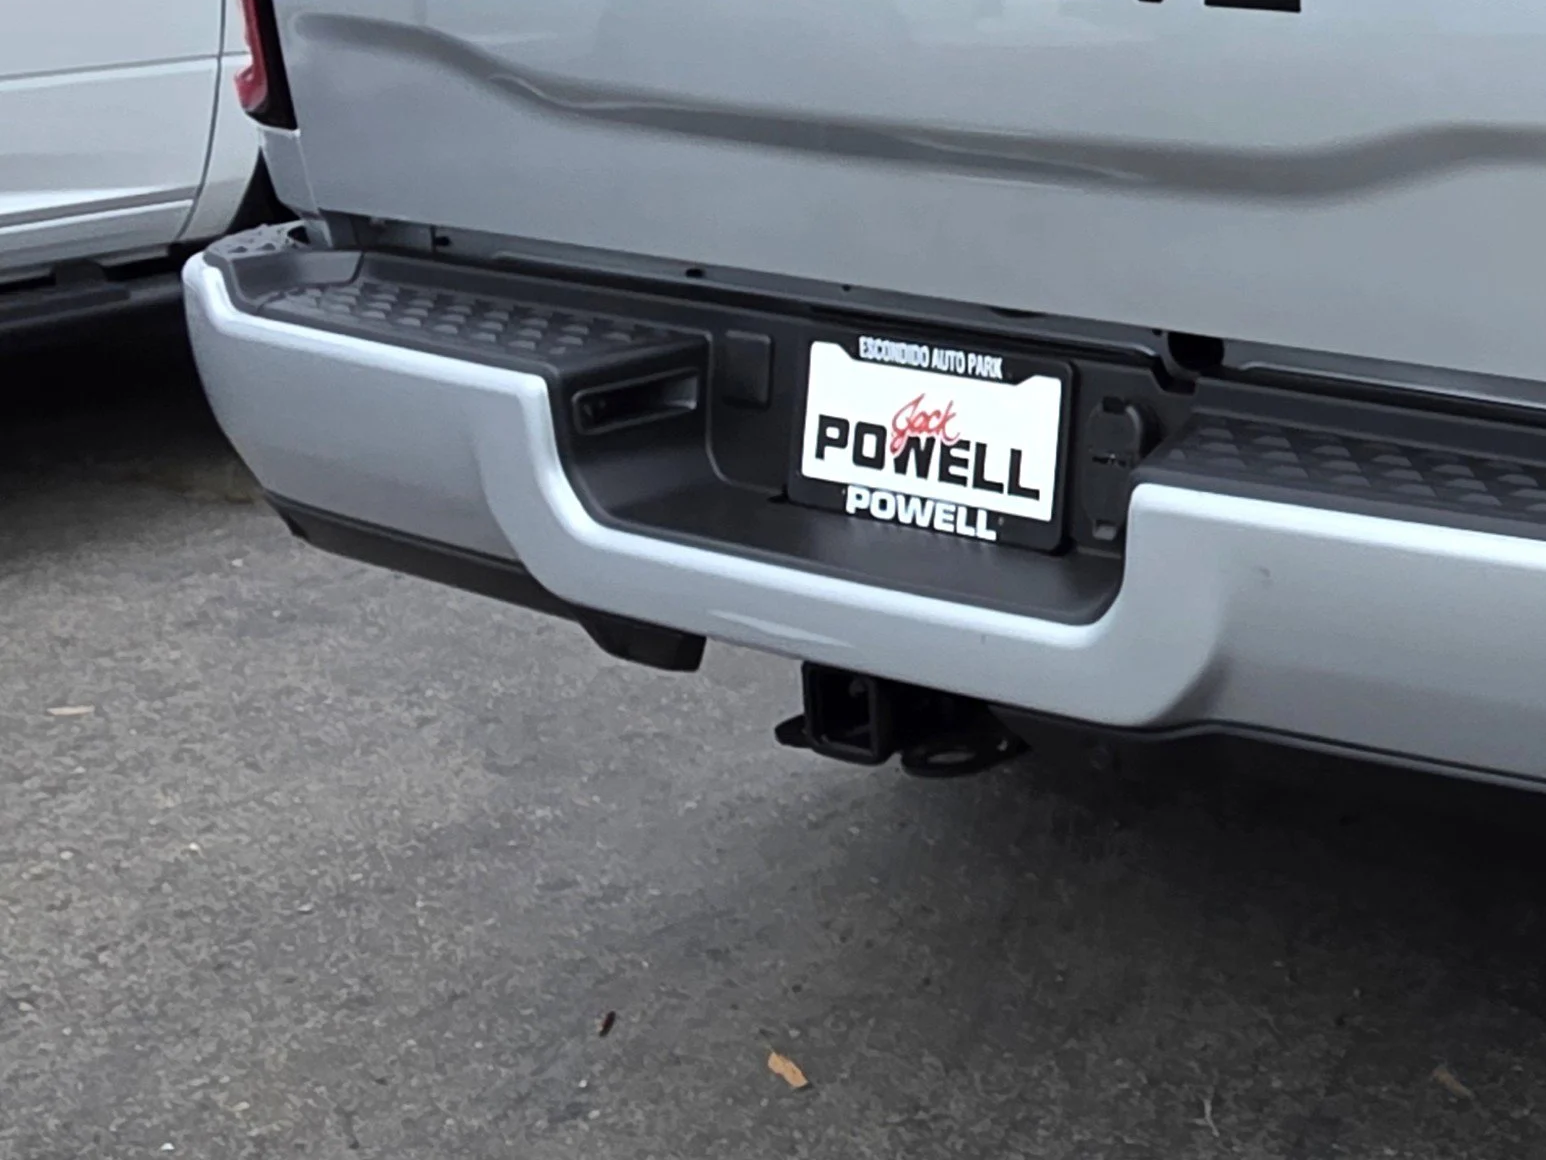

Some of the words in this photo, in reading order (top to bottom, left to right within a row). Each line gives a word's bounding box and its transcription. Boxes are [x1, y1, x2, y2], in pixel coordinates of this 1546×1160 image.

[859, 336, 930, 368] ESCONDIDO
[931, 348, 966, 373] AUTO
[967, 353, 1003, 379] PARK
[889, 393, 961, 455] Jack
[815, 414, 1040, 501] POWELL
[846, 485, 996, 541] POWELL
